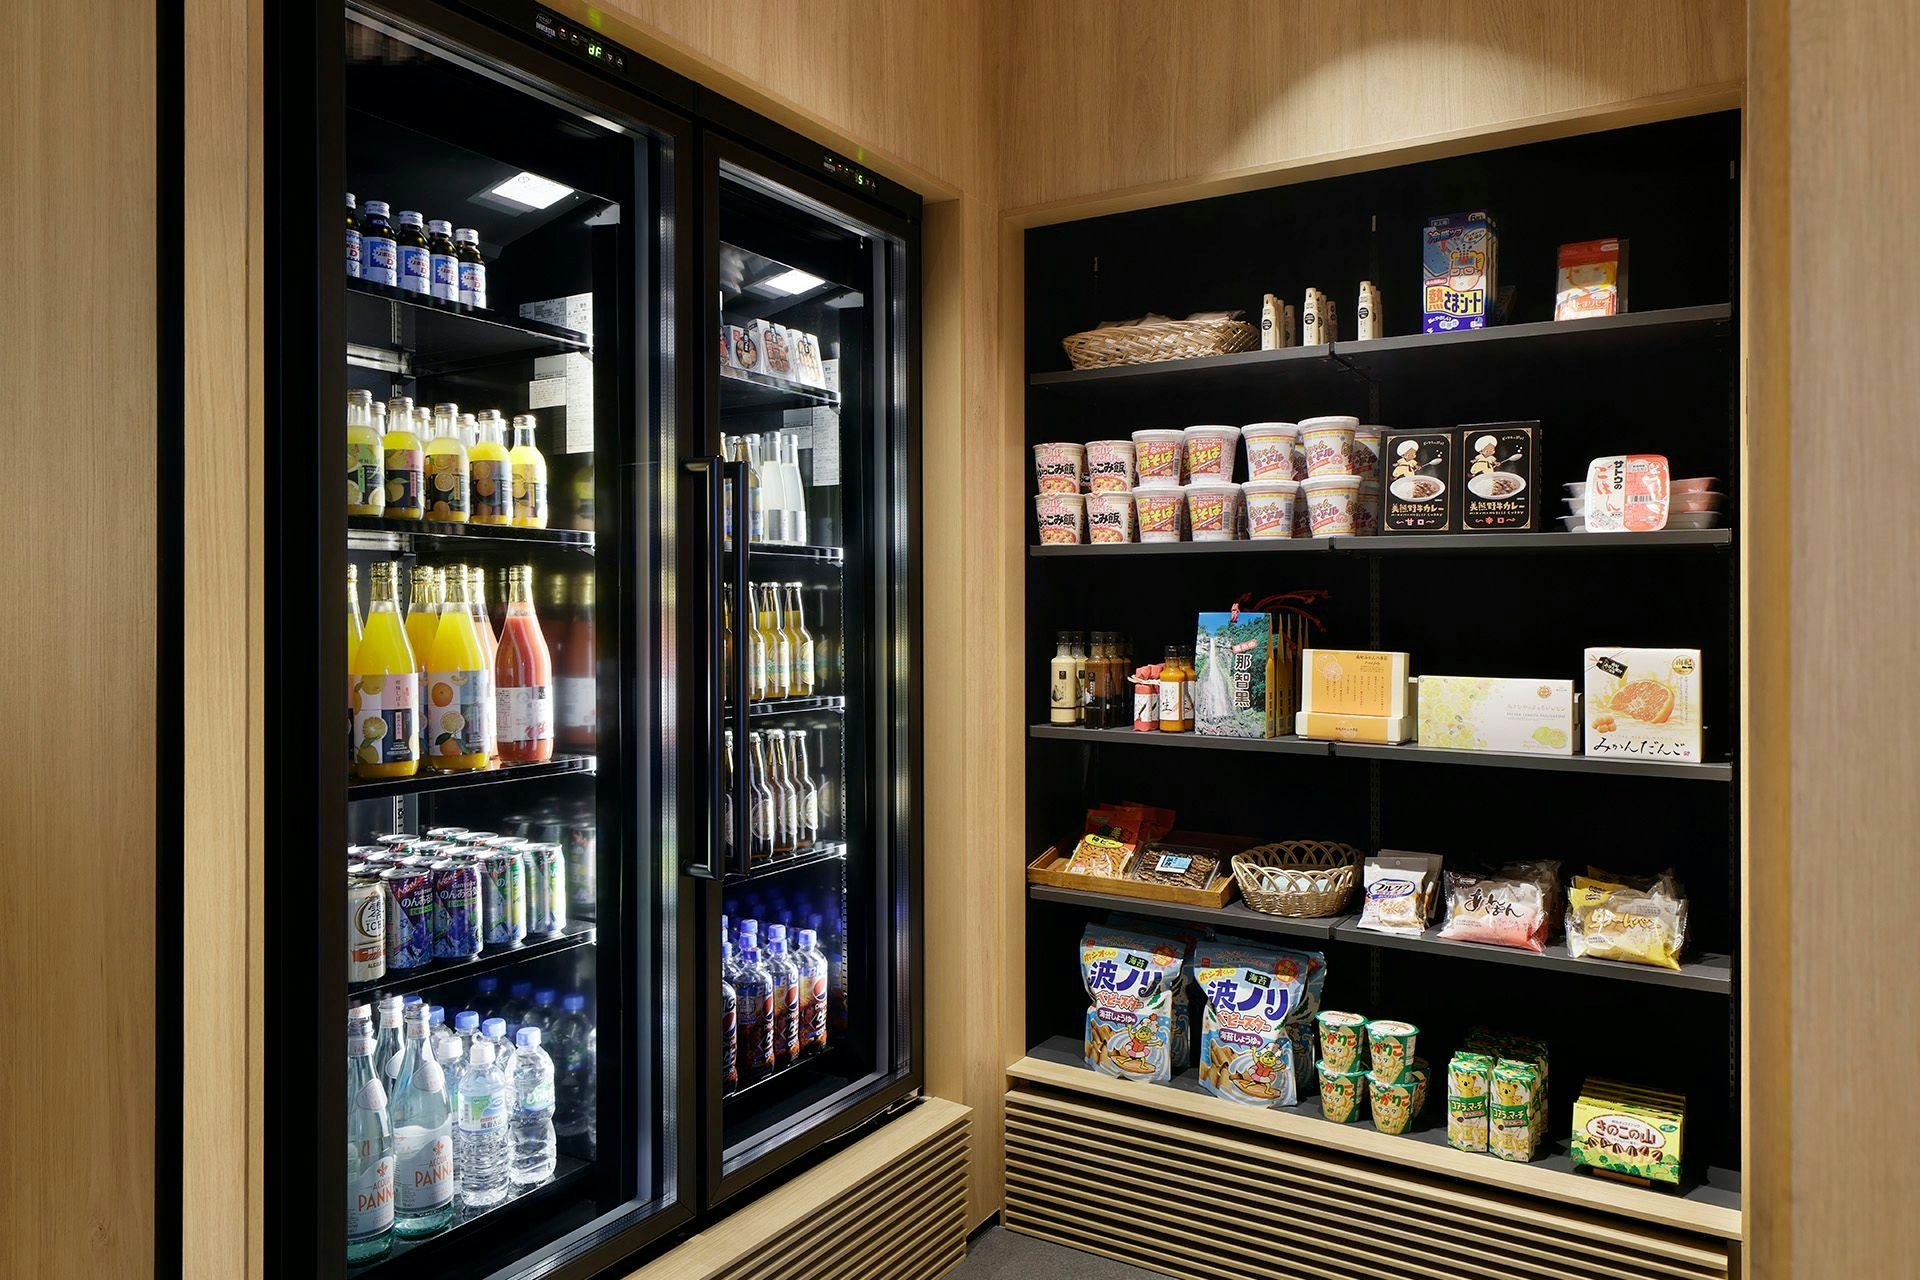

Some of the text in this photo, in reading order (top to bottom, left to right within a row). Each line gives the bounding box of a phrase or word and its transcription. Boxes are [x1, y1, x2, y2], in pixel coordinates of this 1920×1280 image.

[1234, 653, 1252, 708] 那智黒
[1593, 737, 1686, 756] みかんだんご
[1089, 960, 1163, 998] 波ノリ
[1095, 991, 1144, 1011] ベビースター
[1207, 979, 1289, 1020] 波ノリ
[1217, 1010, 1271, 1033] ベビースター
[1451, 1101, 1483, 1112] コアラのマーチ
[1492, 1109, 1525, 1120] コアラのマーチ
[1595, 1120, 1656, 1145] きのこの山
[415, 1165, 450, 1188] PANN
[357, 1186, 393, 1213] PANN
